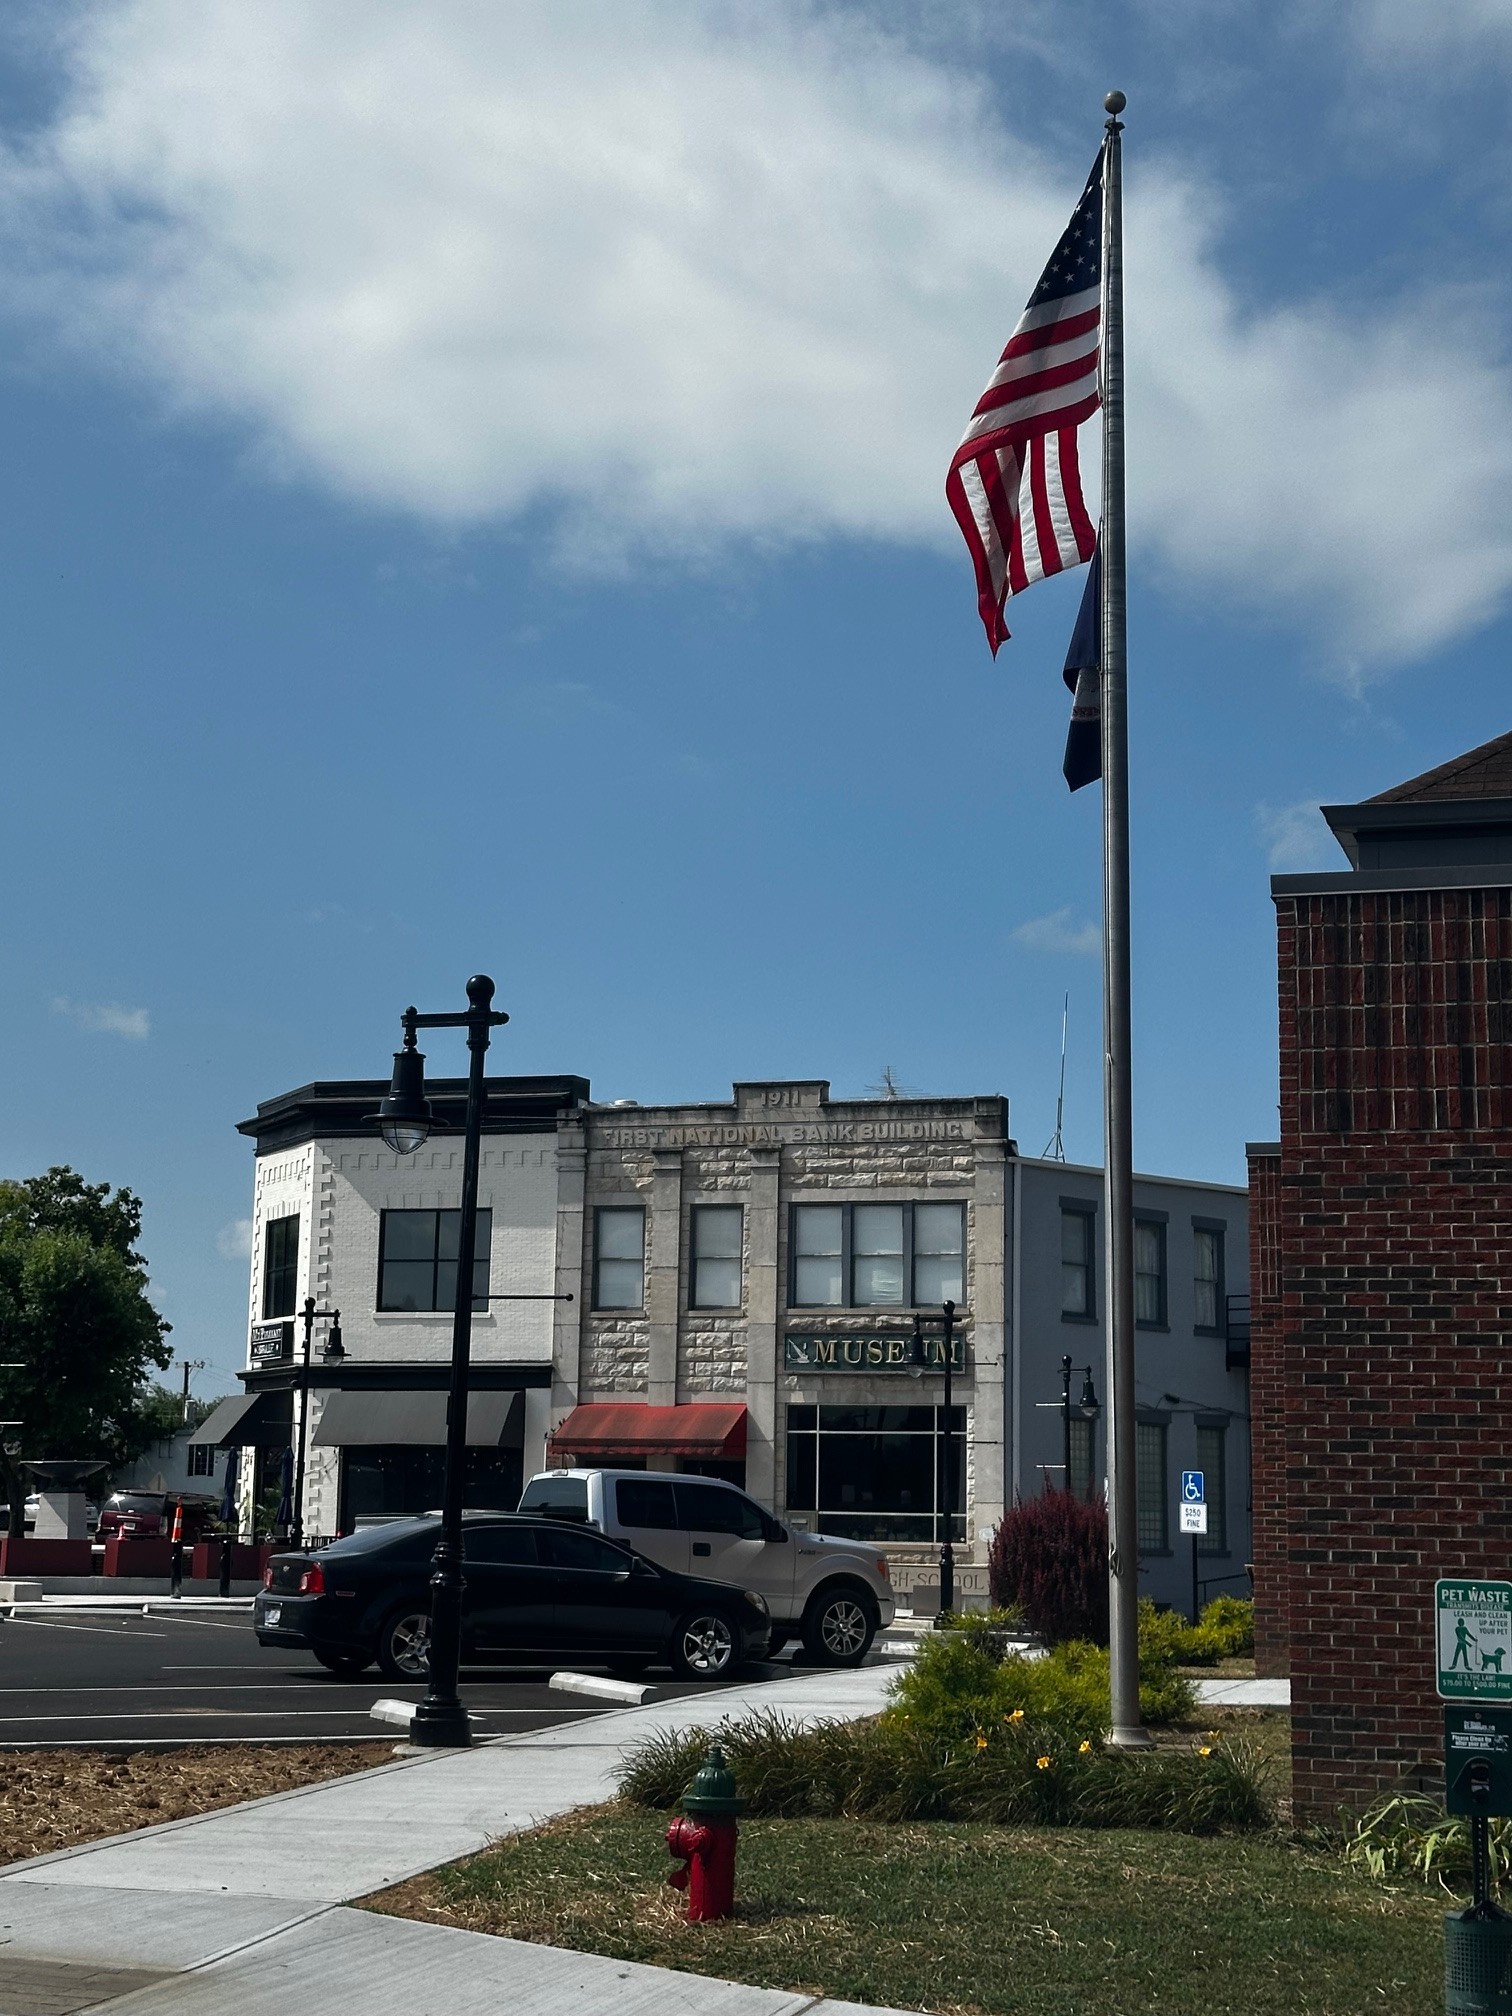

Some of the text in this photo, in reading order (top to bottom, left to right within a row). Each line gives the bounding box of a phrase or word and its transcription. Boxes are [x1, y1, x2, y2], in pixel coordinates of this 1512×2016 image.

[760, 1091, 800, 1107] 1911
[603, 1121, 962, 1146] FIRST NATIONAL BANK BUILDING
[1185, 1507, 1201, 1517] $250
[1187, 1519, 1200, 1528] FINE
[1441, 1588, 1509, 1603] PET WASTE
[1481, 1603, 1505, 1611] DISEASE
